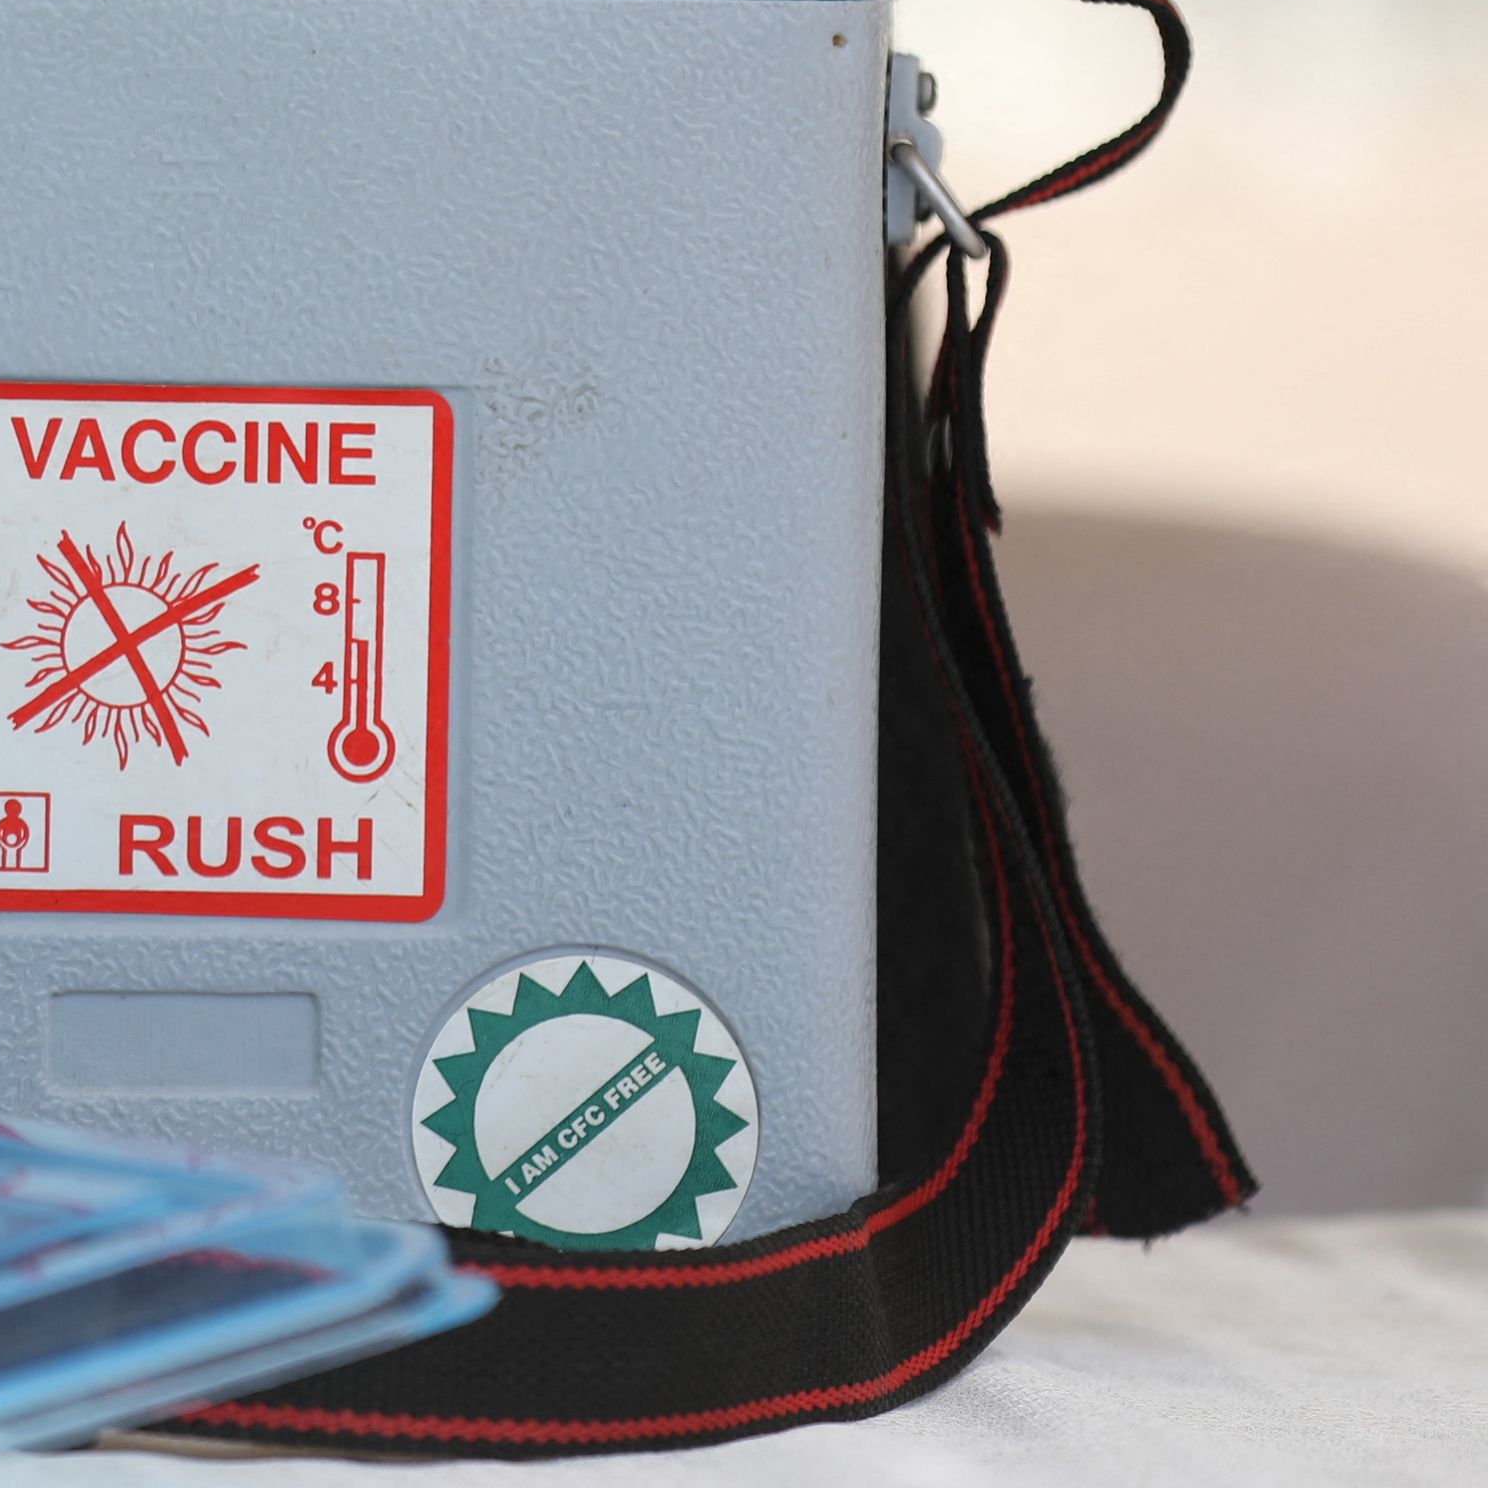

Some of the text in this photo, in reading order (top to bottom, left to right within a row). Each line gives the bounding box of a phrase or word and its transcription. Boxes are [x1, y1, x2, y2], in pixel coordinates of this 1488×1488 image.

[10, 416, 377, 486] VACCINE
[312, 581, 341, 616] 8
[311, 661, 339, 695] 4
[118, 813, 374, 881] RUSH
[503, 1051, 667, 1196] I AM CFC FREE
